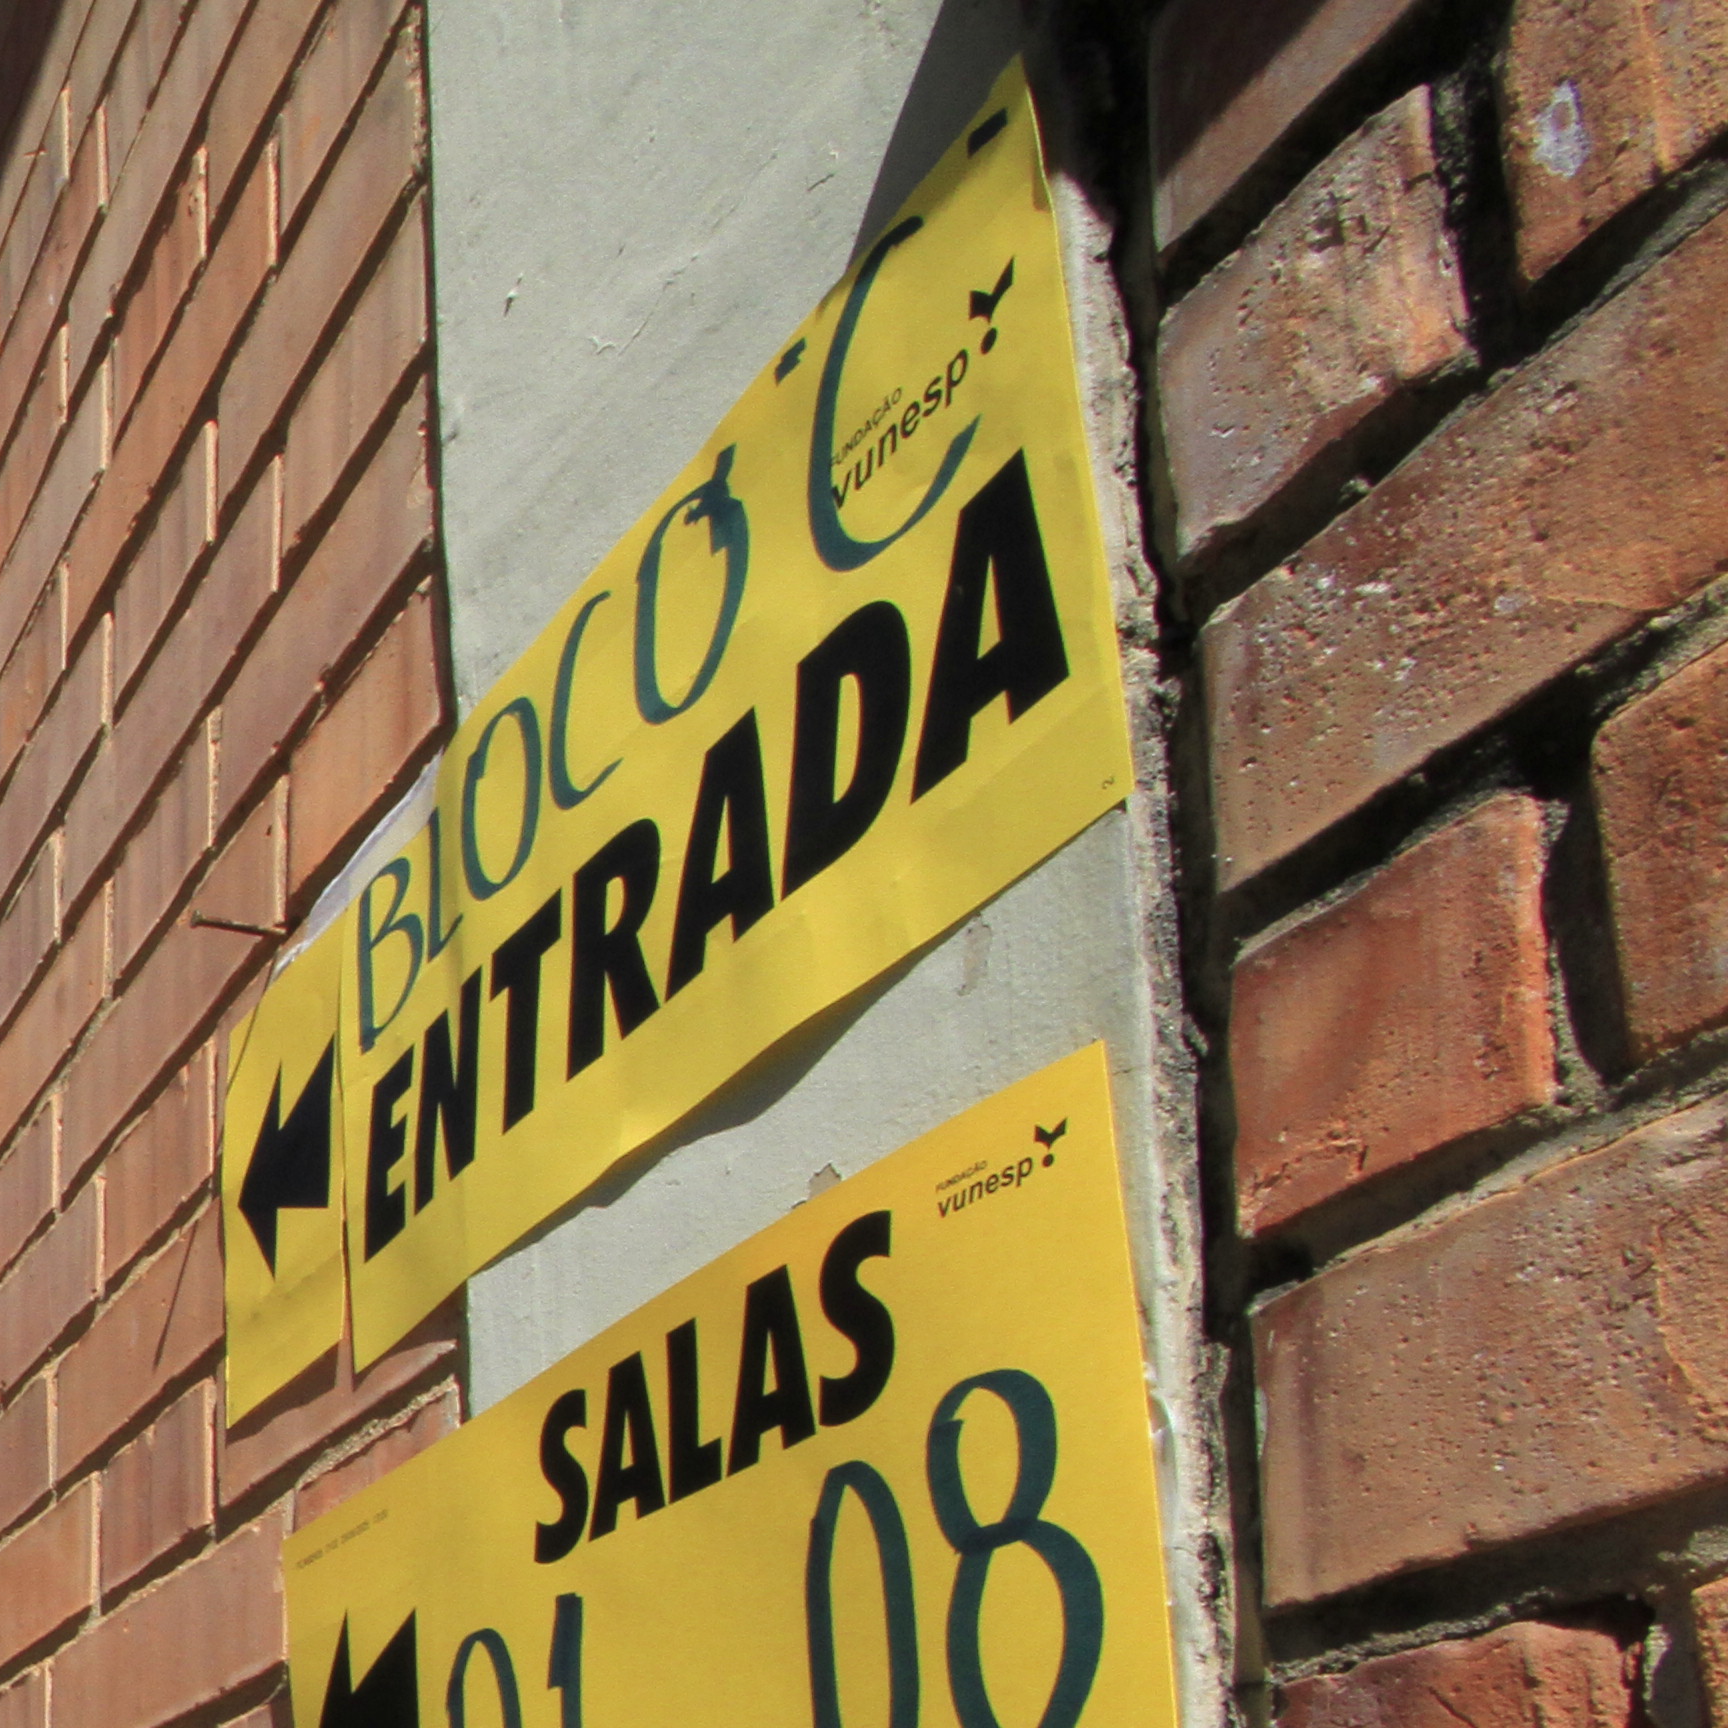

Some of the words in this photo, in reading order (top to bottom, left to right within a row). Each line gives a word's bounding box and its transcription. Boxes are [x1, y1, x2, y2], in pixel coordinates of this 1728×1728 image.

[831, 348, 969, 509] vunesp
[357, 444, 750, 1055] BLOCO
[364, 447, 1071, 1263] ENTRADA
[937, 1156, 1033, 1218] vunesp
[534, 1210, 896, 1564] SALAS
